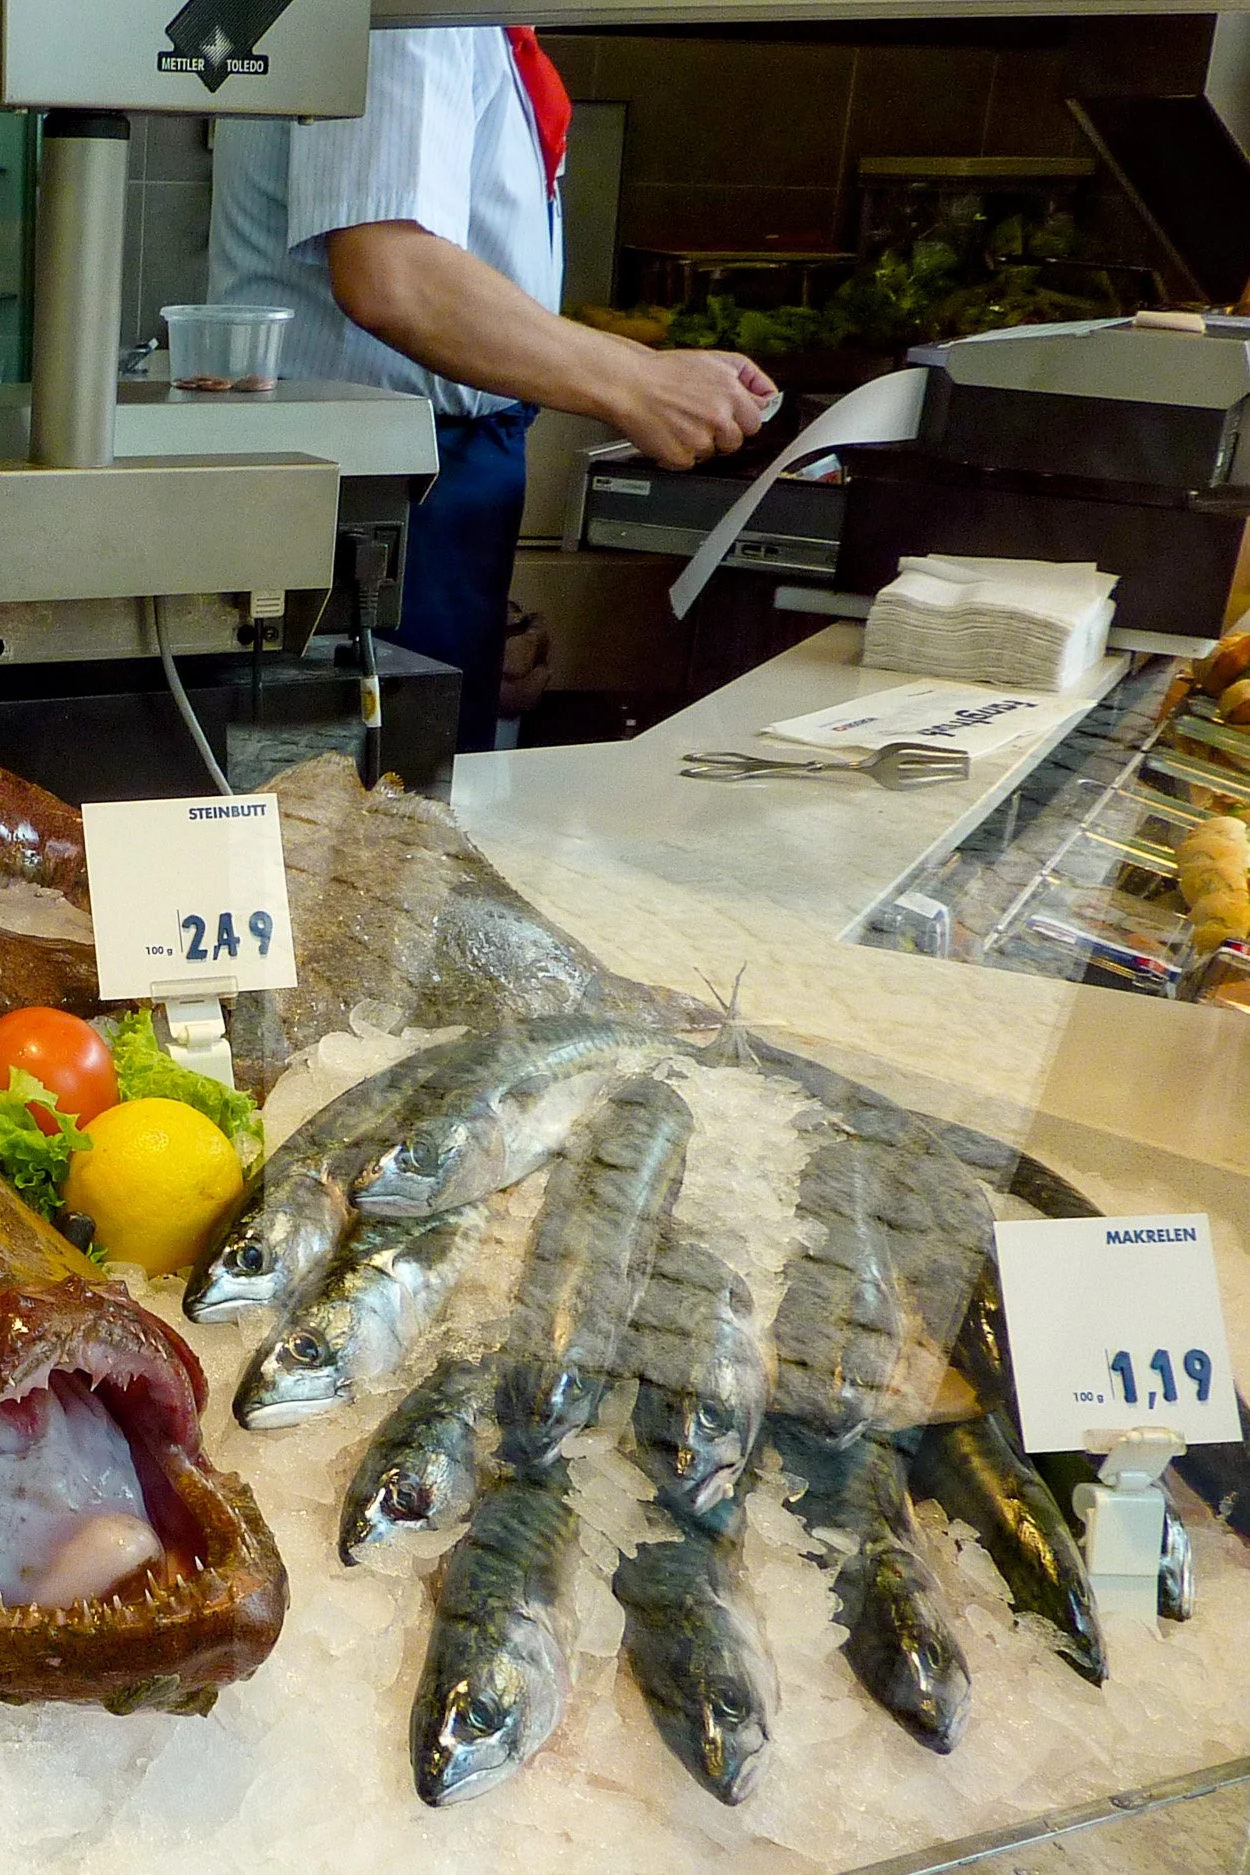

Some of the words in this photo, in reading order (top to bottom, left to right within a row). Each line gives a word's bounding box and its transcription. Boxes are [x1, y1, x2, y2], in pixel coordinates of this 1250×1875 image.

[161, 57, 205, 72] METTLER
[226, 58, 264, 73] TOLEDO
[188, 804, 267, 820] STEINBUTT
[145, 946, 164, 956] 100
[166, 948, 173, 957] g
[181, 910, 274, 961] 2,49
[1106, 1227, 1197, 1245] MAKRELEN
[1073, 1392, 1094, 1402] 100
[1097, 1394, 1104, 1404] g
[1111, 1348, 1212, 1410] 1,19
